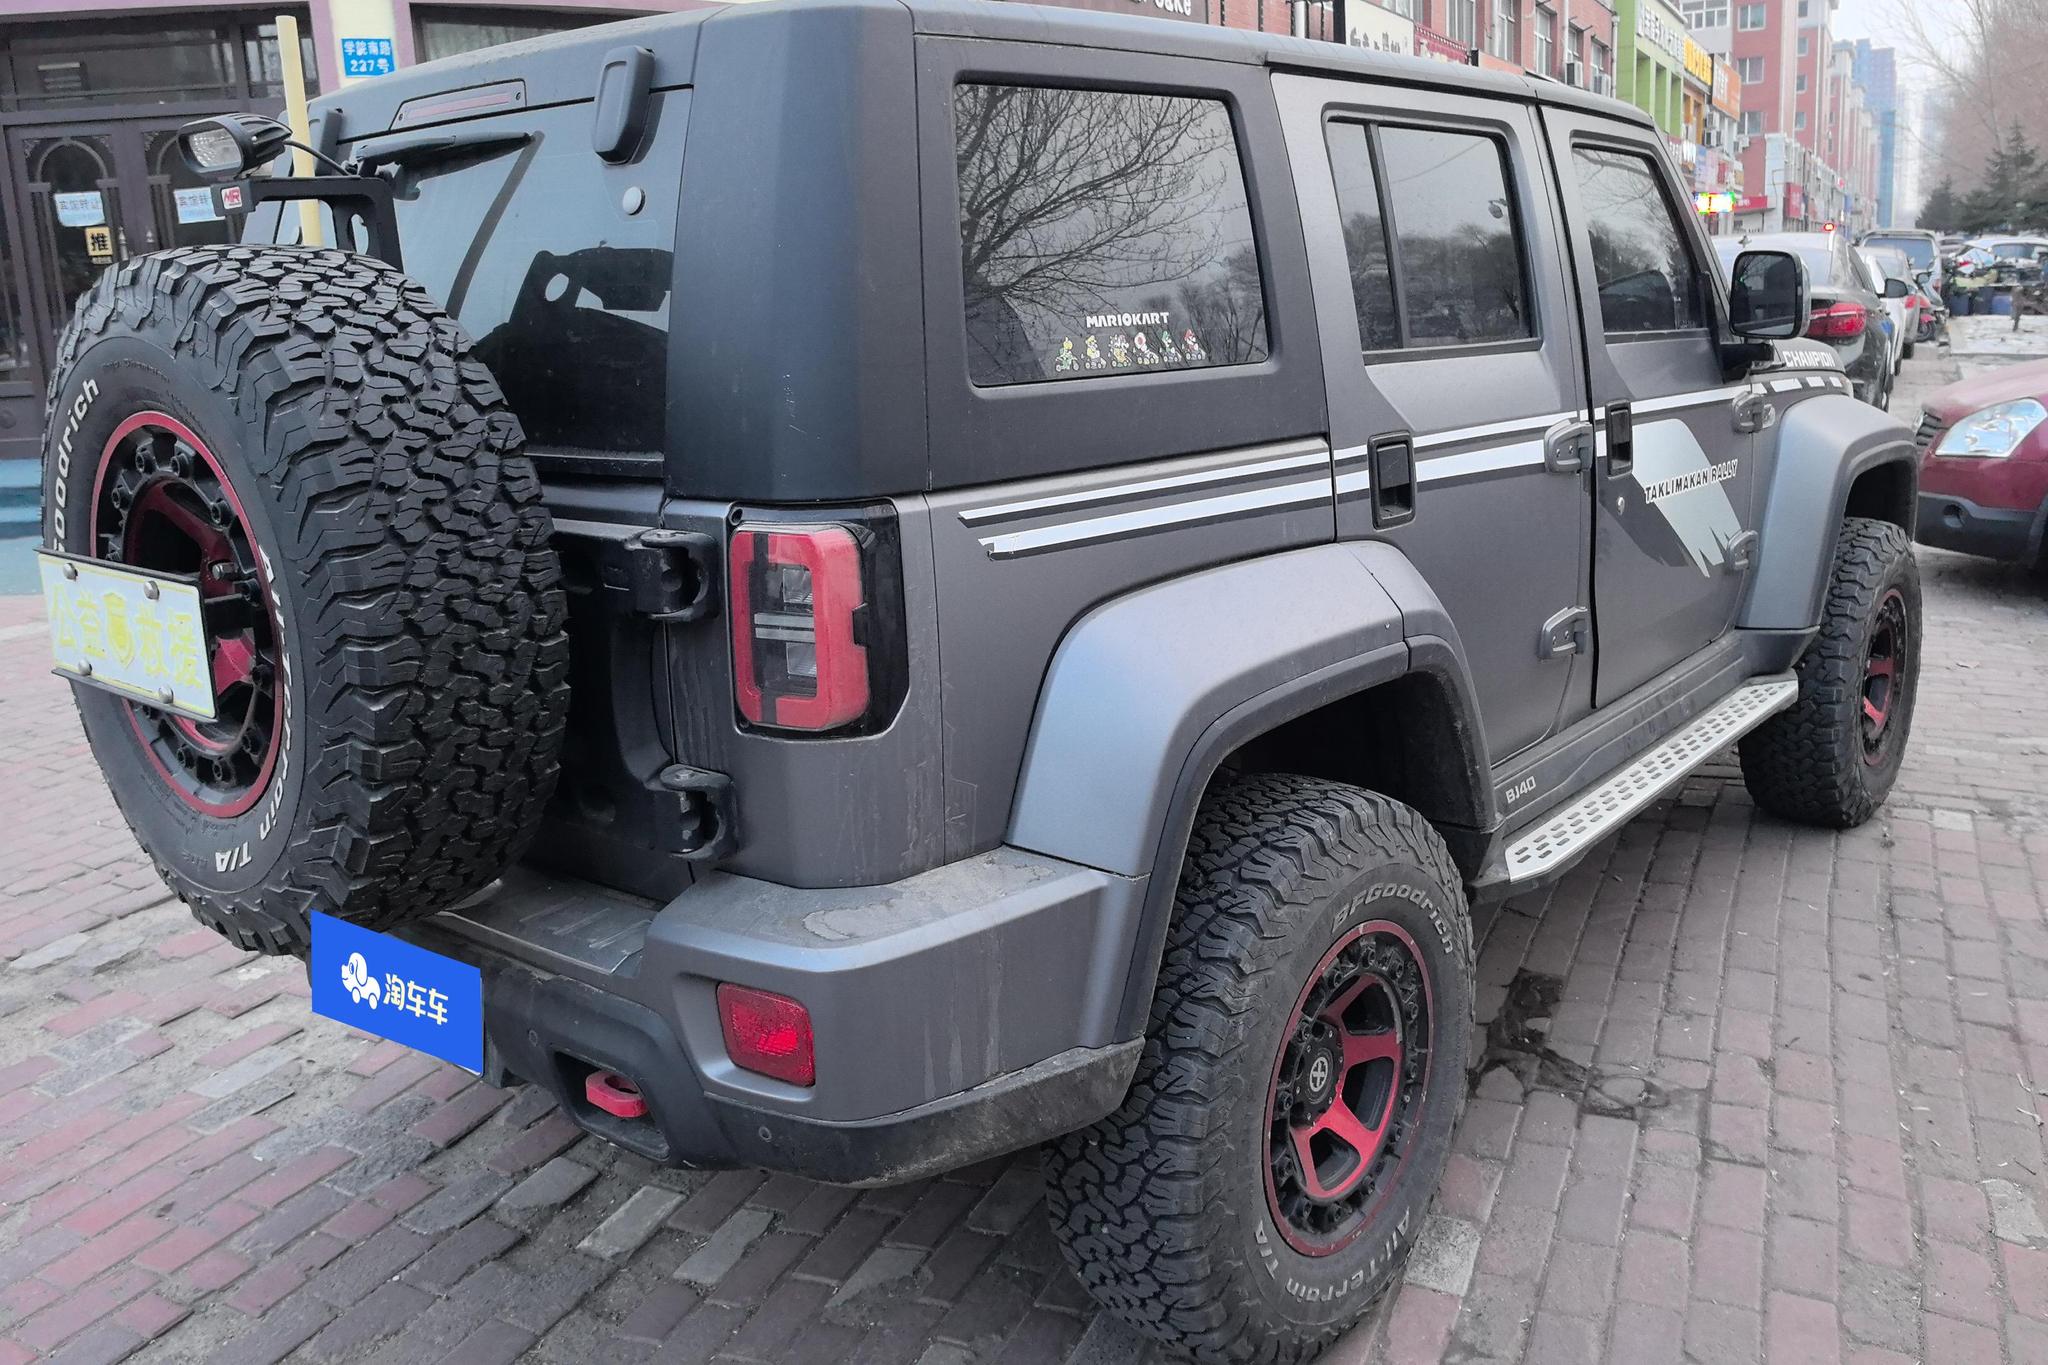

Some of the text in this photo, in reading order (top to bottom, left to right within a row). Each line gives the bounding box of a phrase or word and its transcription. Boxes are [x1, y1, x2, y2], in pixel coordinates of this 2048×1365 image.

[91, 232, 109, 252] 推
[1782, 350, 1836, 368] CHAMPION
[1644, 458, 1739, 504] TAKLIMAKAN RALLY
[1505, 775, 1537, 804] BJ40
[215, 842, 252, 873] T/A
[1331, 882, 1454, 954] BFGoodrich
